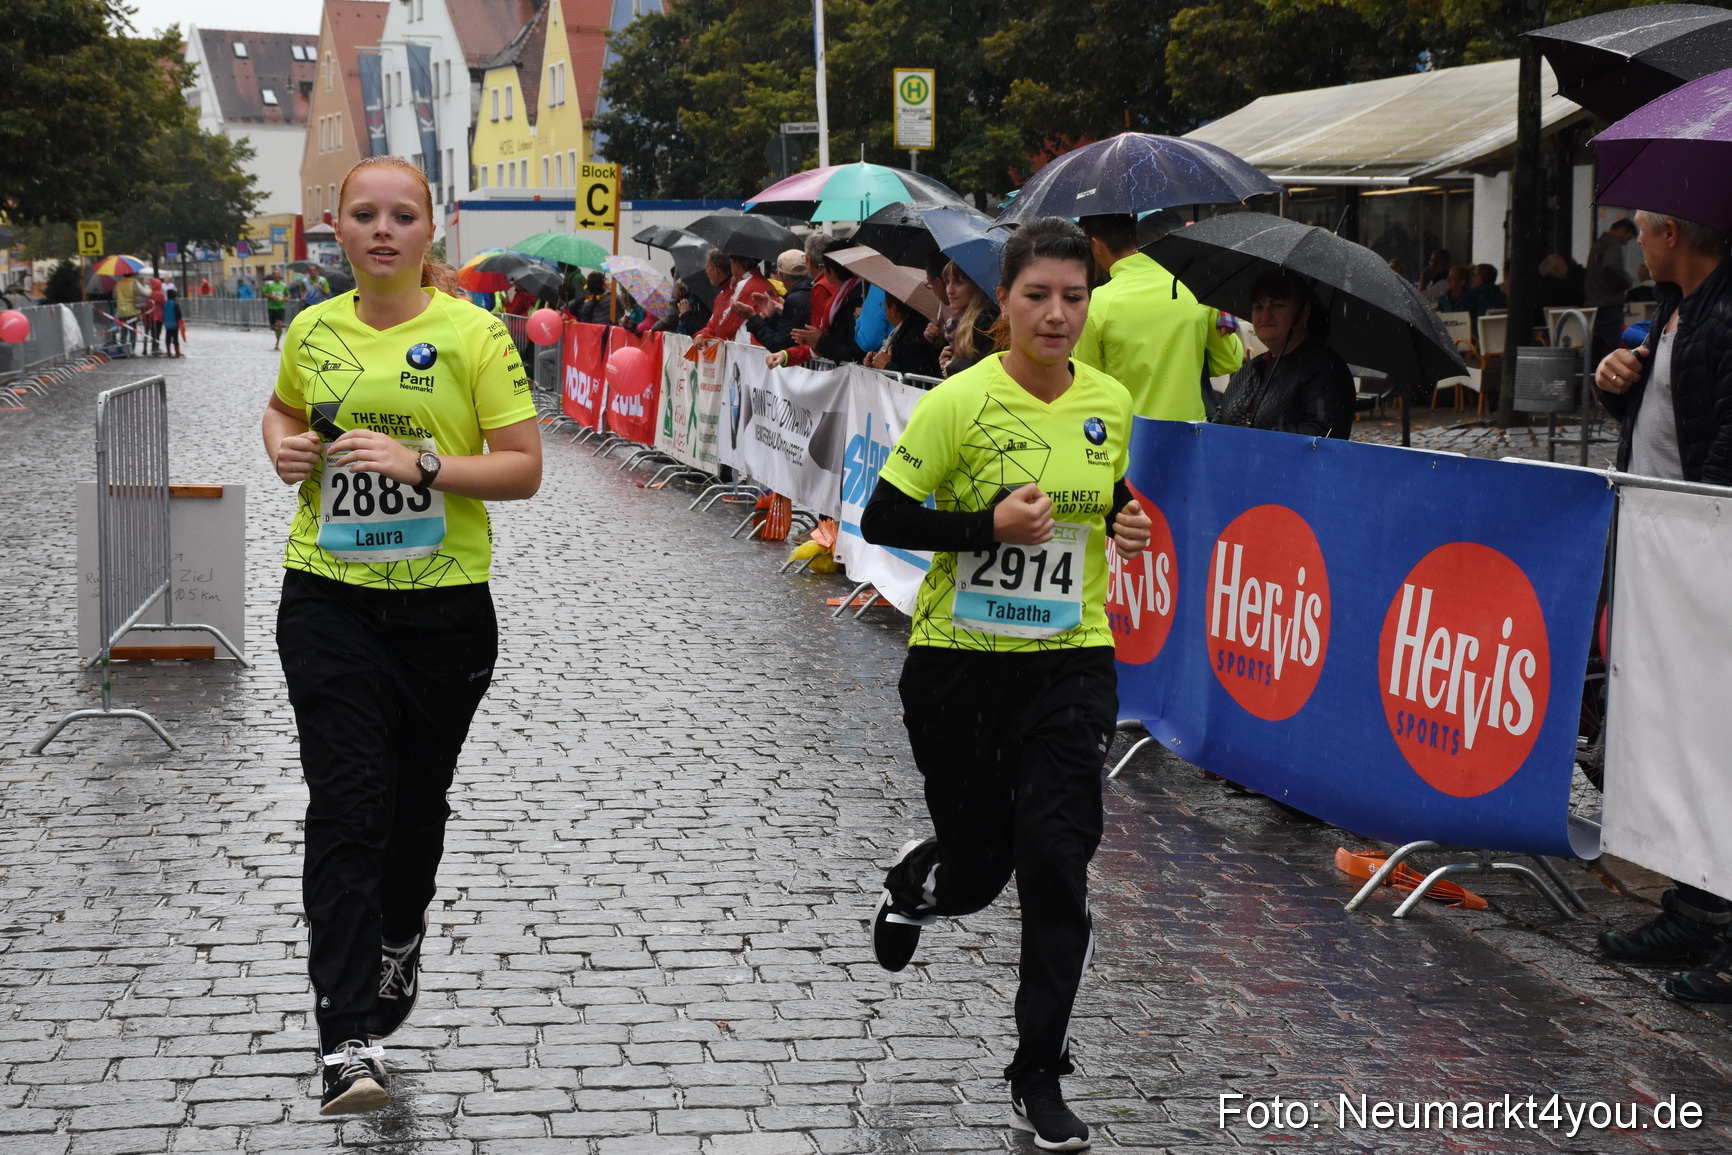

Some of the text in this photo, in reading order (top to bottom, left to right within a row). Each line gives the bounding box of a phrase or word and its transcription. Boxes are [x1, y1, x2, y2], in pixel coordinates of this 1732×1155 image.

[582, 165, 616, 179] Block
[587, 183, 609, 216] C
[84, 232, 97, 248] D
[400, 371, 435, 387] Partl
[400, 383, 434, 394] Neumarkt
[351, 412, 412, 427] THE NEXT
[896, 445, 923, 470] Partl
[1085, 448, 1109, 461] Partl
[1046, 490, 1100, 503] THE NEXT
[1056, 504, 1077, 514] 100
[356, 529, 403, 546] Laura
[179, 568, 213, 583] Ziel
[970, 546, 1073, 594] 2914
[987, 600, 1051, 623] Tabatha
[1211, 540, 1322, 681] Hervis
[1217, 649, 1272, 686] SPORTS
[1388, 583, 1536, 750] Hervis
[1396, 710, 1460, 756] SPORTS
